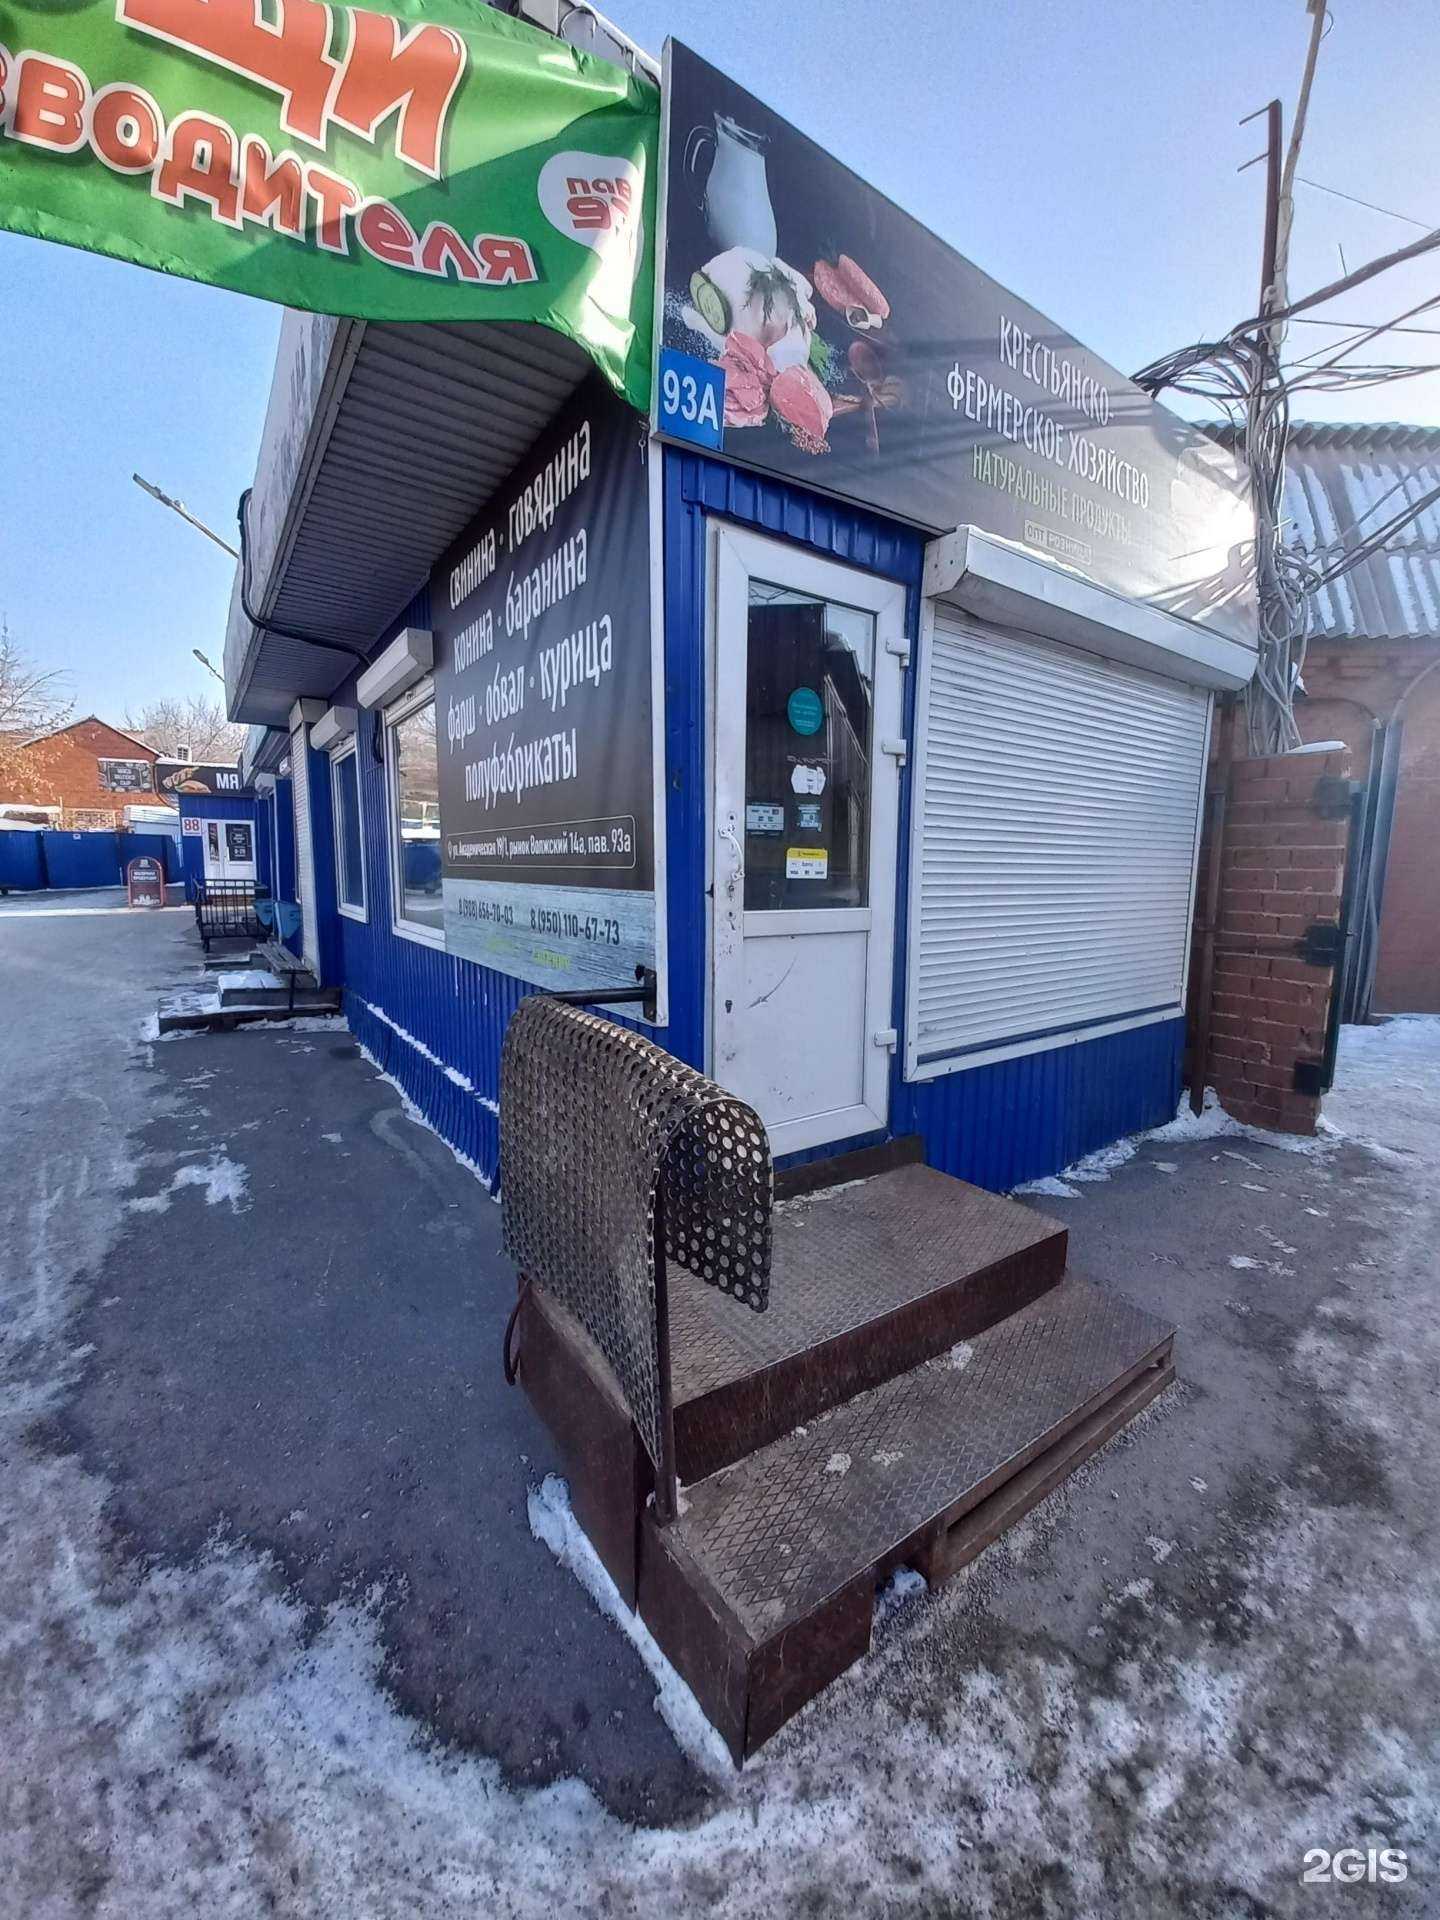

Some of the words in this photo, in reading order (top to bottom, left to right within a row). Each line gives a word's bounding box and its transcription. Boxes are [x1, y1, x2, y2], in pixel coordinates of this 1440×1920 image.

[663, 368, 719, 433] 93А
[1000, 315, 1115, 426] КРЕСТЬЯНСКО-
[947, 362, 1064, 467] ФЕРМЕРСКОЕ
[1068, 431, 1149, 509] ХОЗЯЙСТВО
[973, 443, 1068, 518] НАТУРАЛЬНЫЕ
[1071, 492, 1132, 545] ПРОДУКТЫ
[454, 608, 493, 675] конина
[506, 528, 588, 641] баранина
[447, 695, 476, 755] фарш
[486, 662, 525, 726] обвал
[465, 728, 578, 811] полуфабрикаты
[184, 819, 200, 831] 88
[588, 835, 610, 853] пав.
[611, 828, 631, 853] 93а
[530, 908, 536, 930] 8
[538, 908, 562, 939] (950)
[563, 913, 620, 946] 110-67-73
